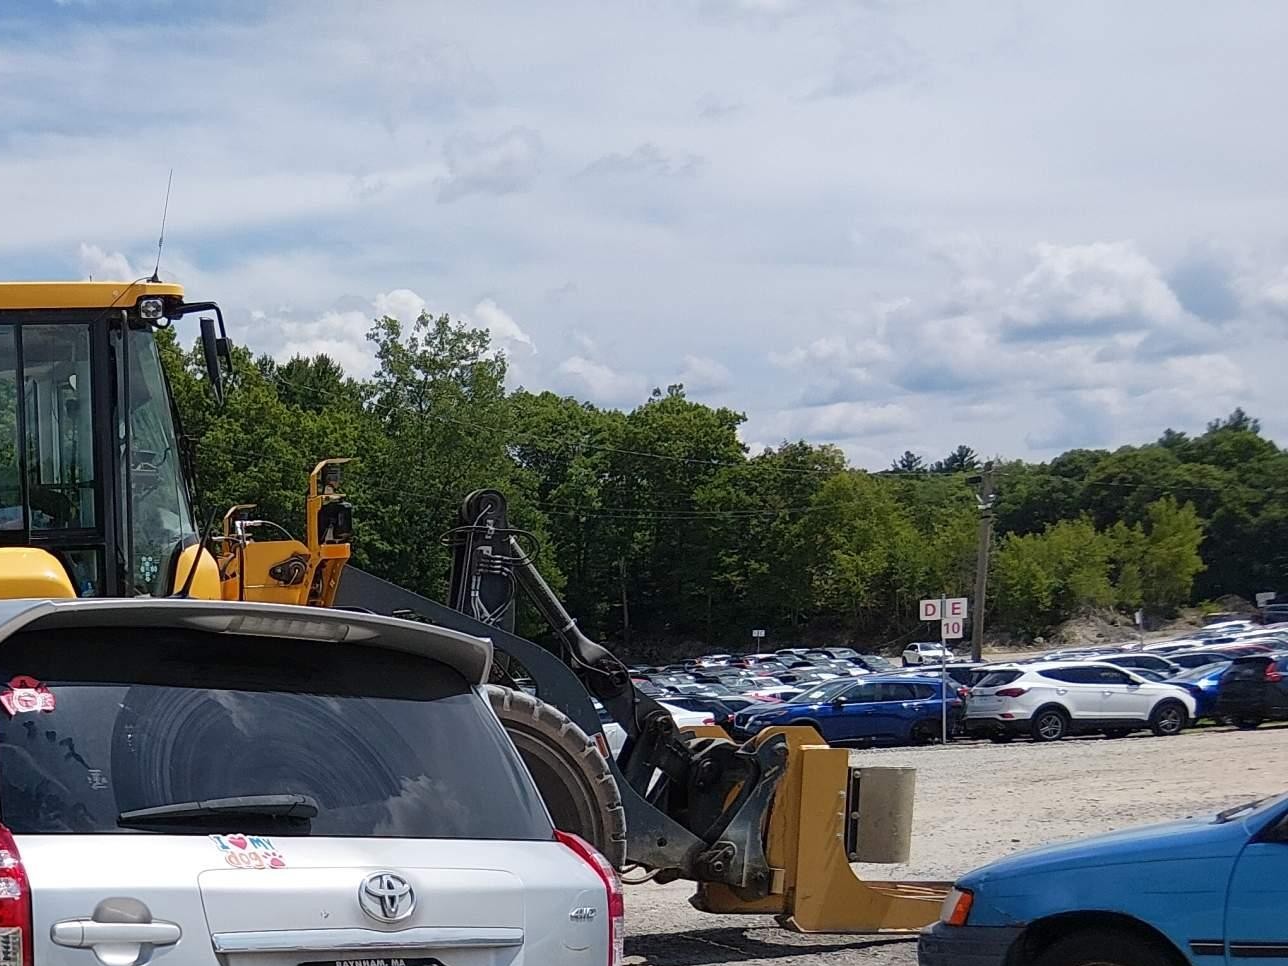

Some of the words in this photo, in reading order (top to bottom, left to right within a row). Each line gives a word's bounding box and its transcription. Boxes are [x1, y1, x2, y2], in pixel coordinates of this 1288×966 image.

[925, 603, 936, 616] D
[952, 602, 961, 615] E
[944, 622, 960, 634] 10
[213, 836, 231, 849] I
[227, 851, 265, 869] dog
[392, 959, 406, 966] MA
